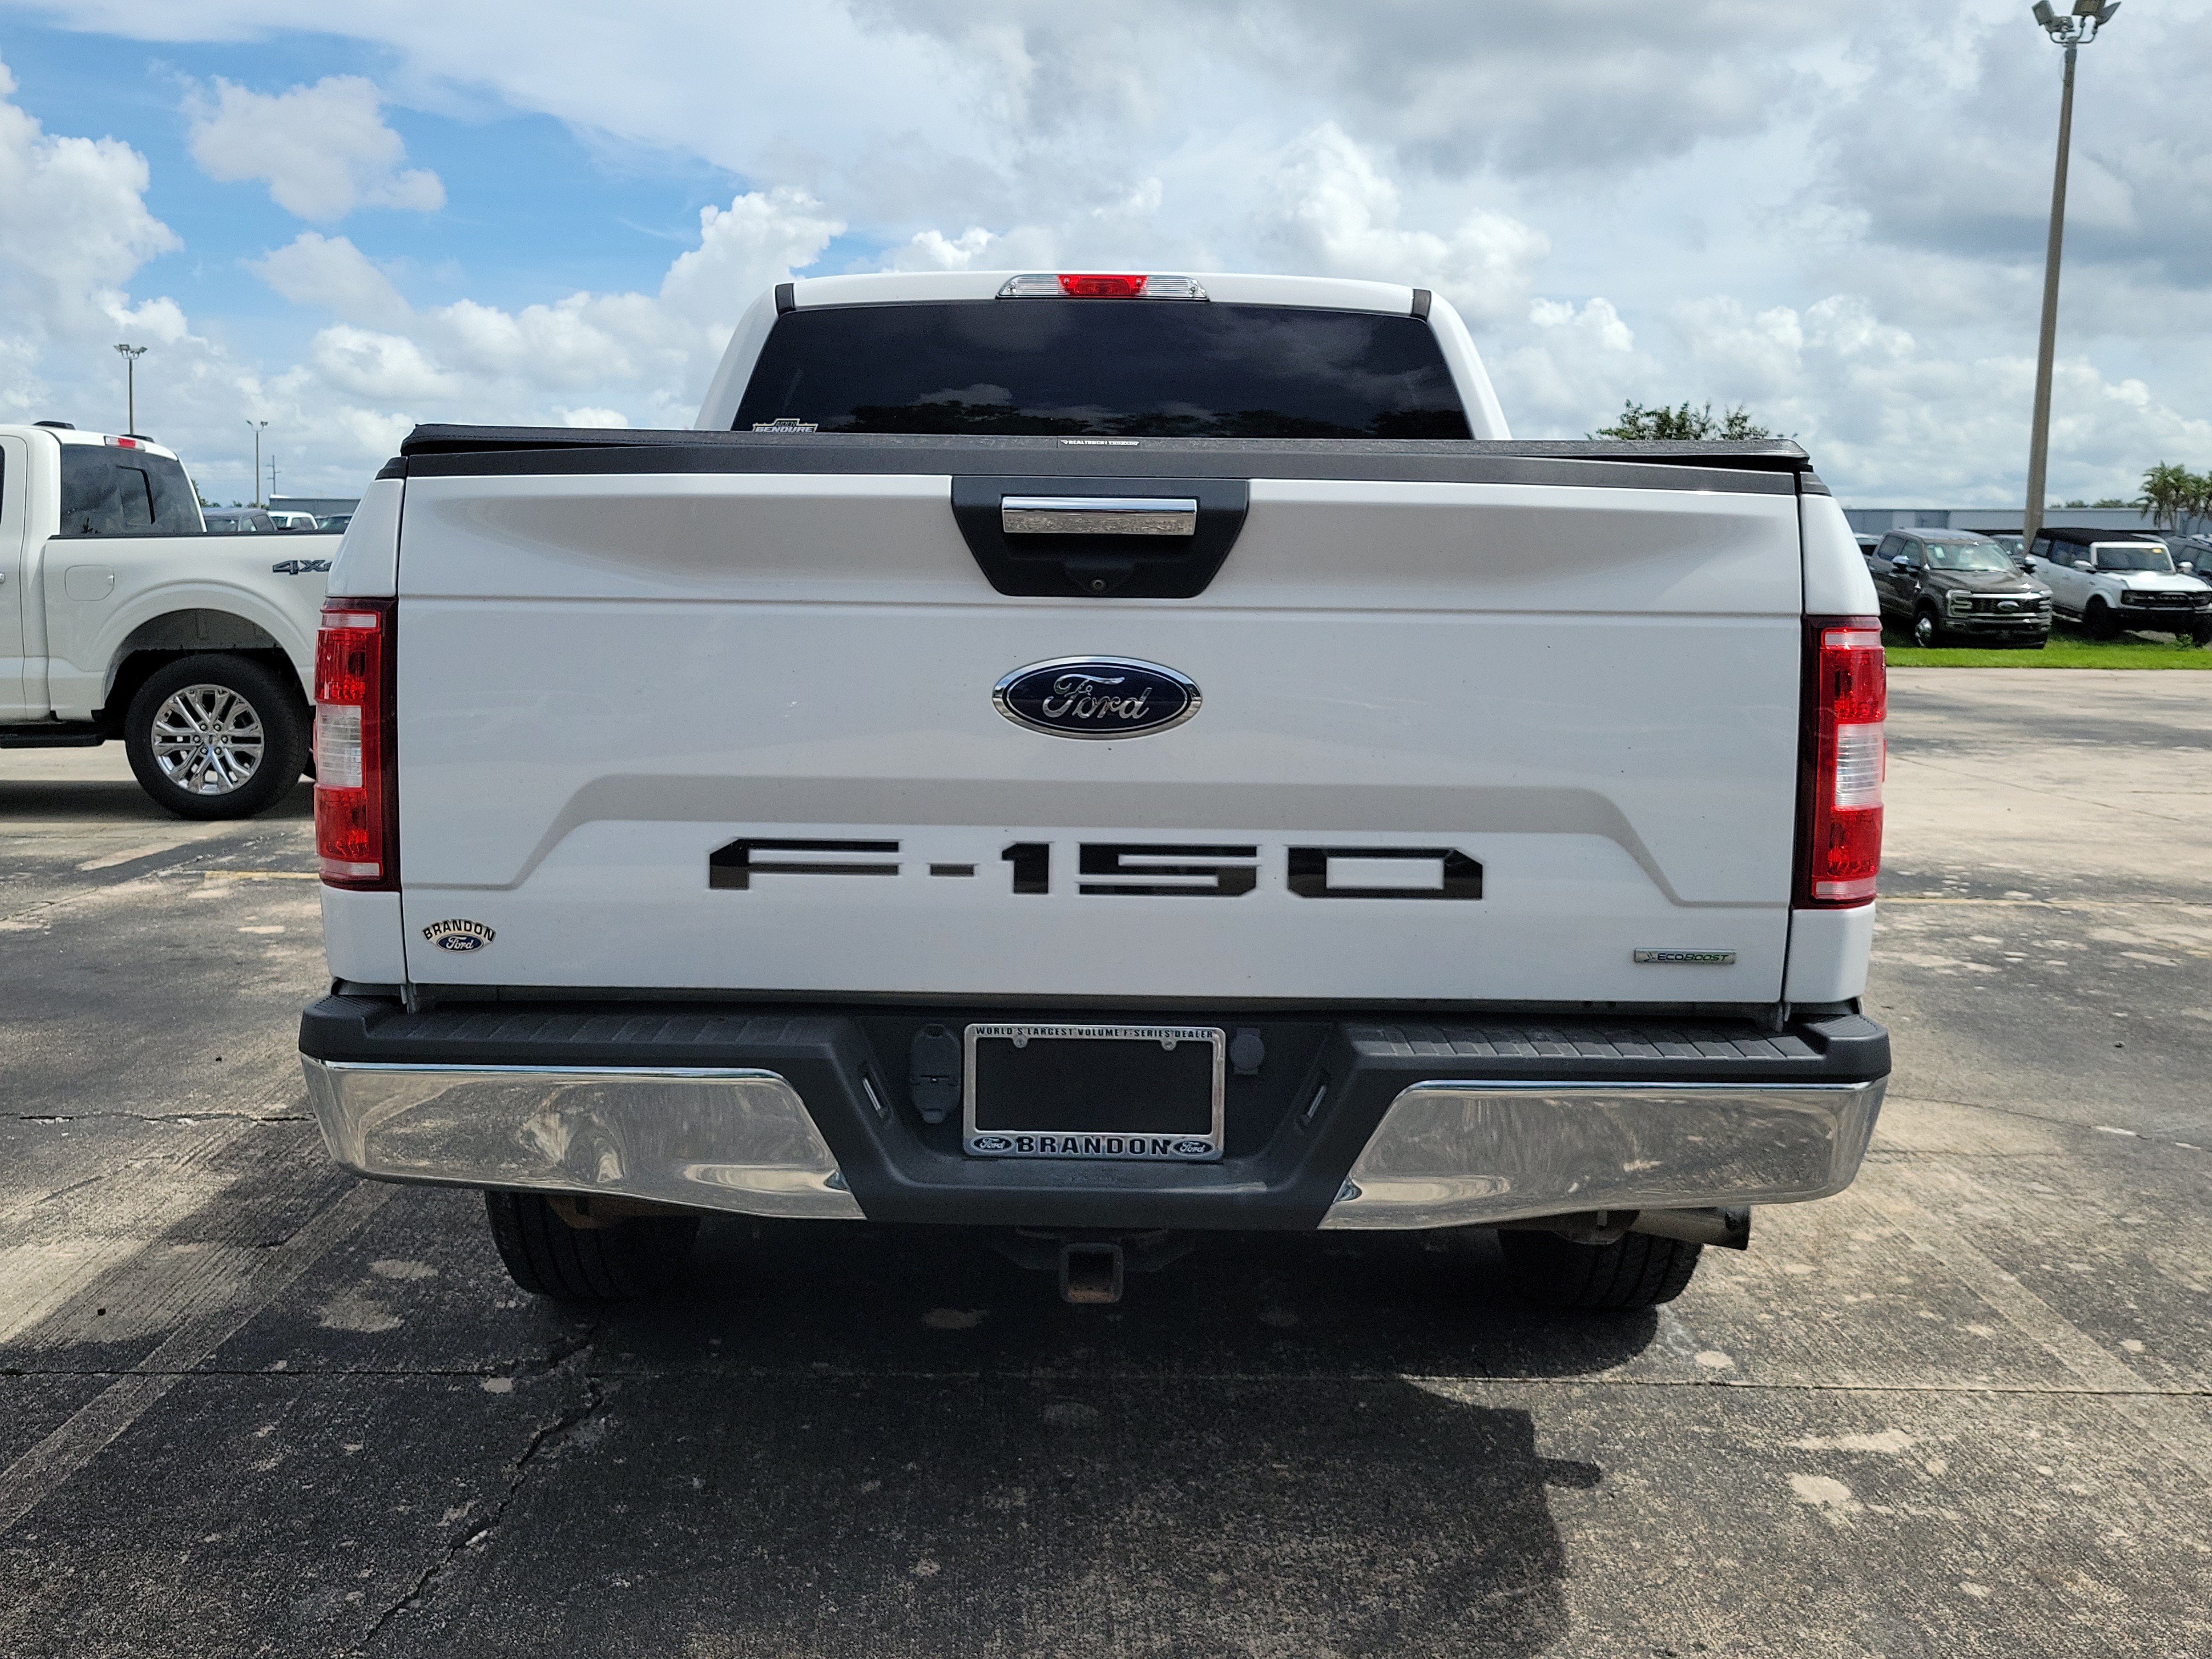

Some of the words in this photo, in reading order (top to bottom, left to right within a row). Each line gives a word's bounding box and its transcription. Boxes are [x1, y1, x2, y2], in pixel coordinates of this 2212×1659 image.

[272, 560, 332, 575] 4X
[1042, 673, 1153, 719] Ford
[709, 839, 1483, 899] F-150
[422, 919, 495, 942] BRANDON
[446, 936, 474, 949] Ford
[1028, 1027, 1073, 1036] LARGEST
[1077, 1028, 1119, 1036] VOLUME
[979, 1138, 1006, 1149] Ford
[1016, 1136, 1171, 1155] BRANDON
[1180, 1141, 1206, 1153] Ford
